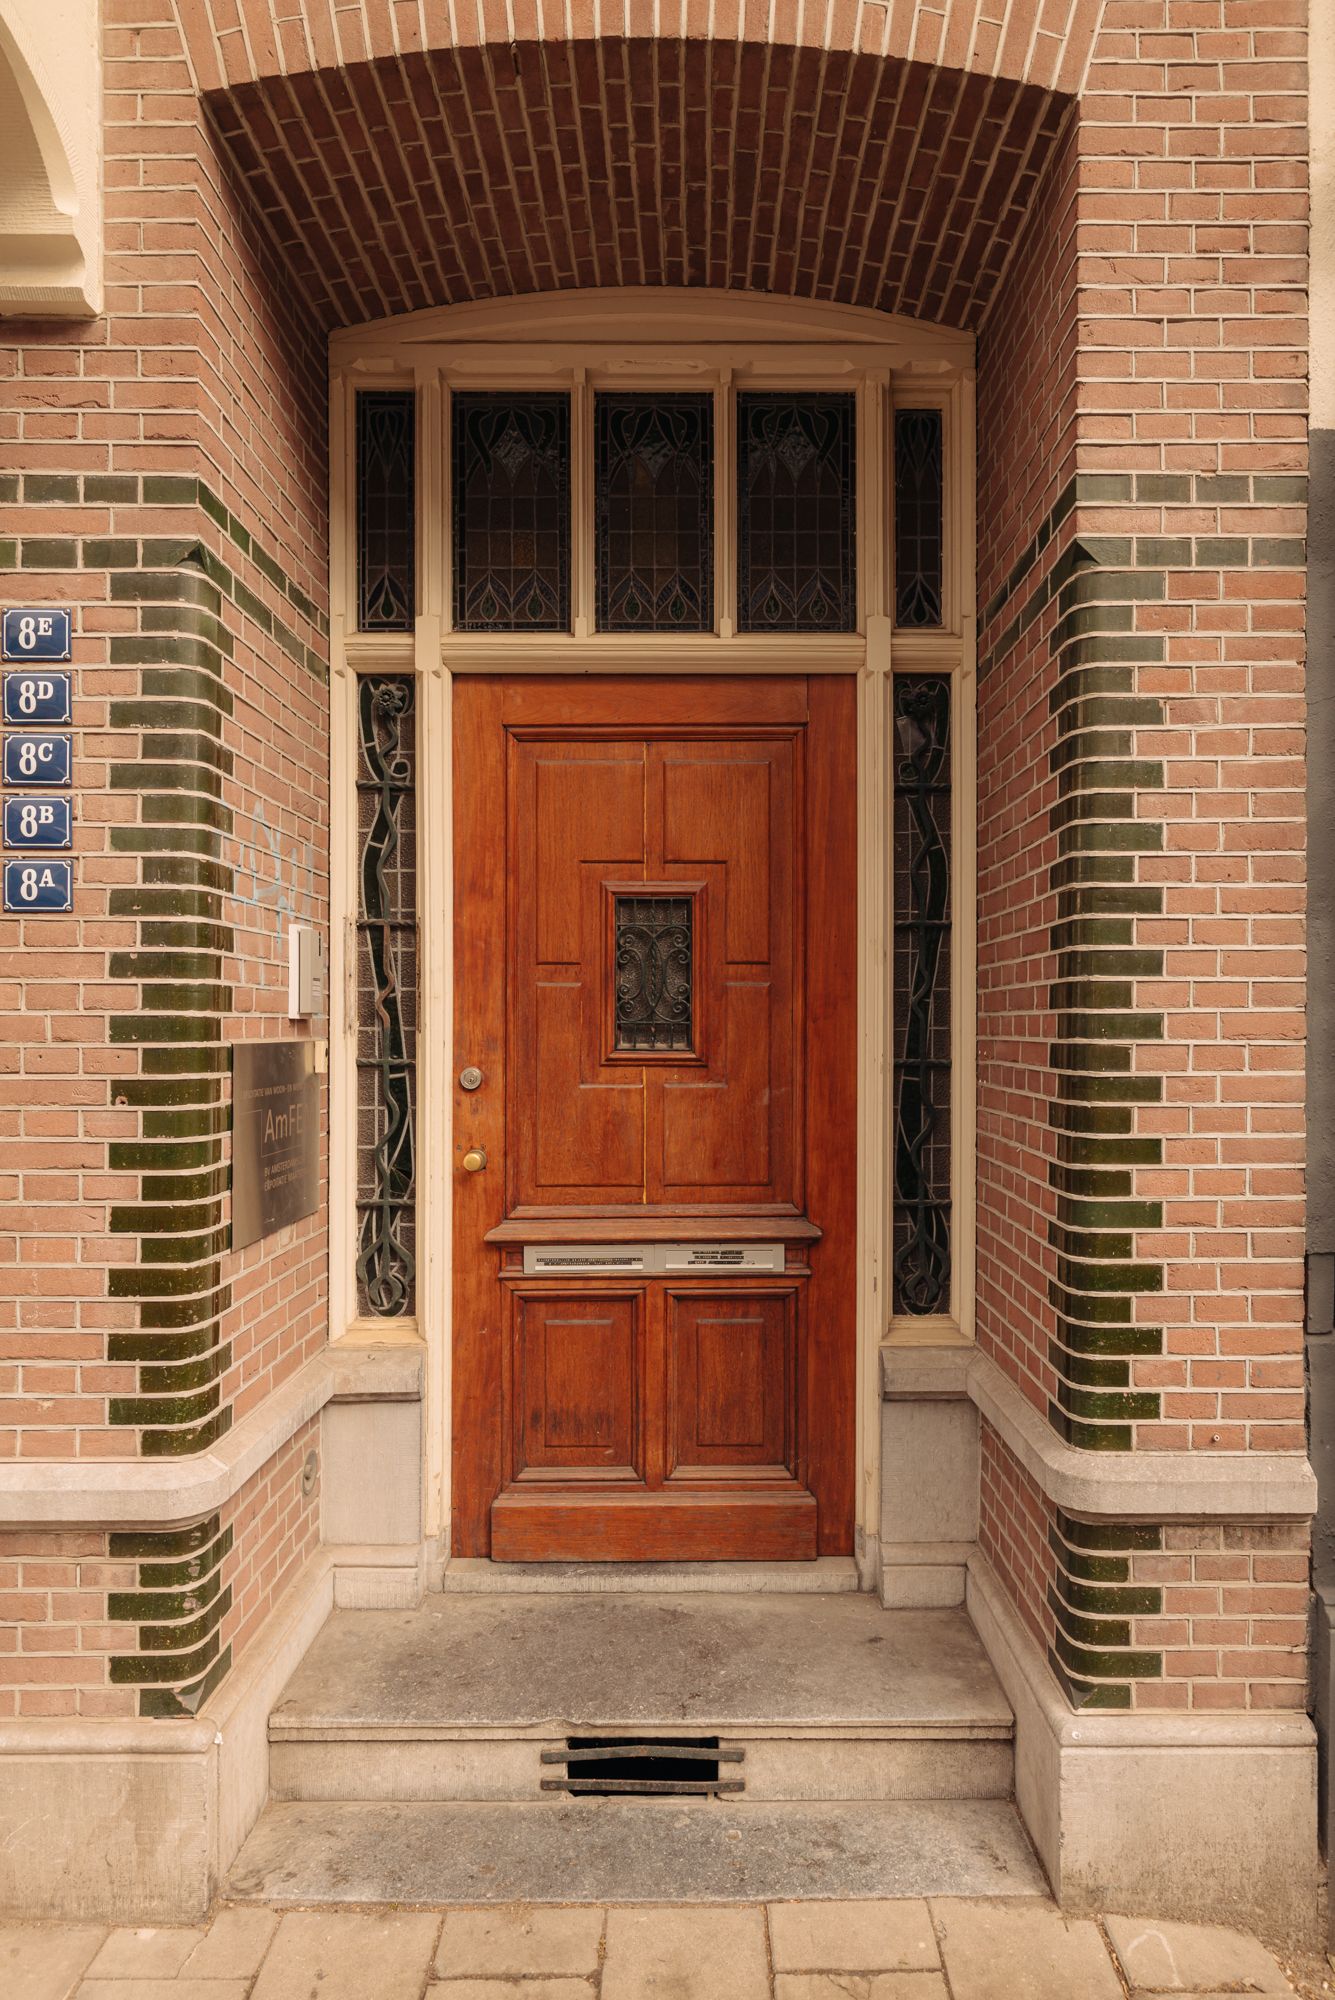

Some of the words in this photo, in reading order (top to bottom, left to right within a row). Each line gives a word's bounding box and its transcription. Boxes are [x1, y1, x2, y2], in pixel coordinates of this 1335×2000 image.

[18, 617, 53, 649] 8E
[19, 680, 54, 713] 8D
[19, 742, 54, 775] 8C
[20, 805, 54, 838] 8B
[20, 868, 56, 901] 8A
